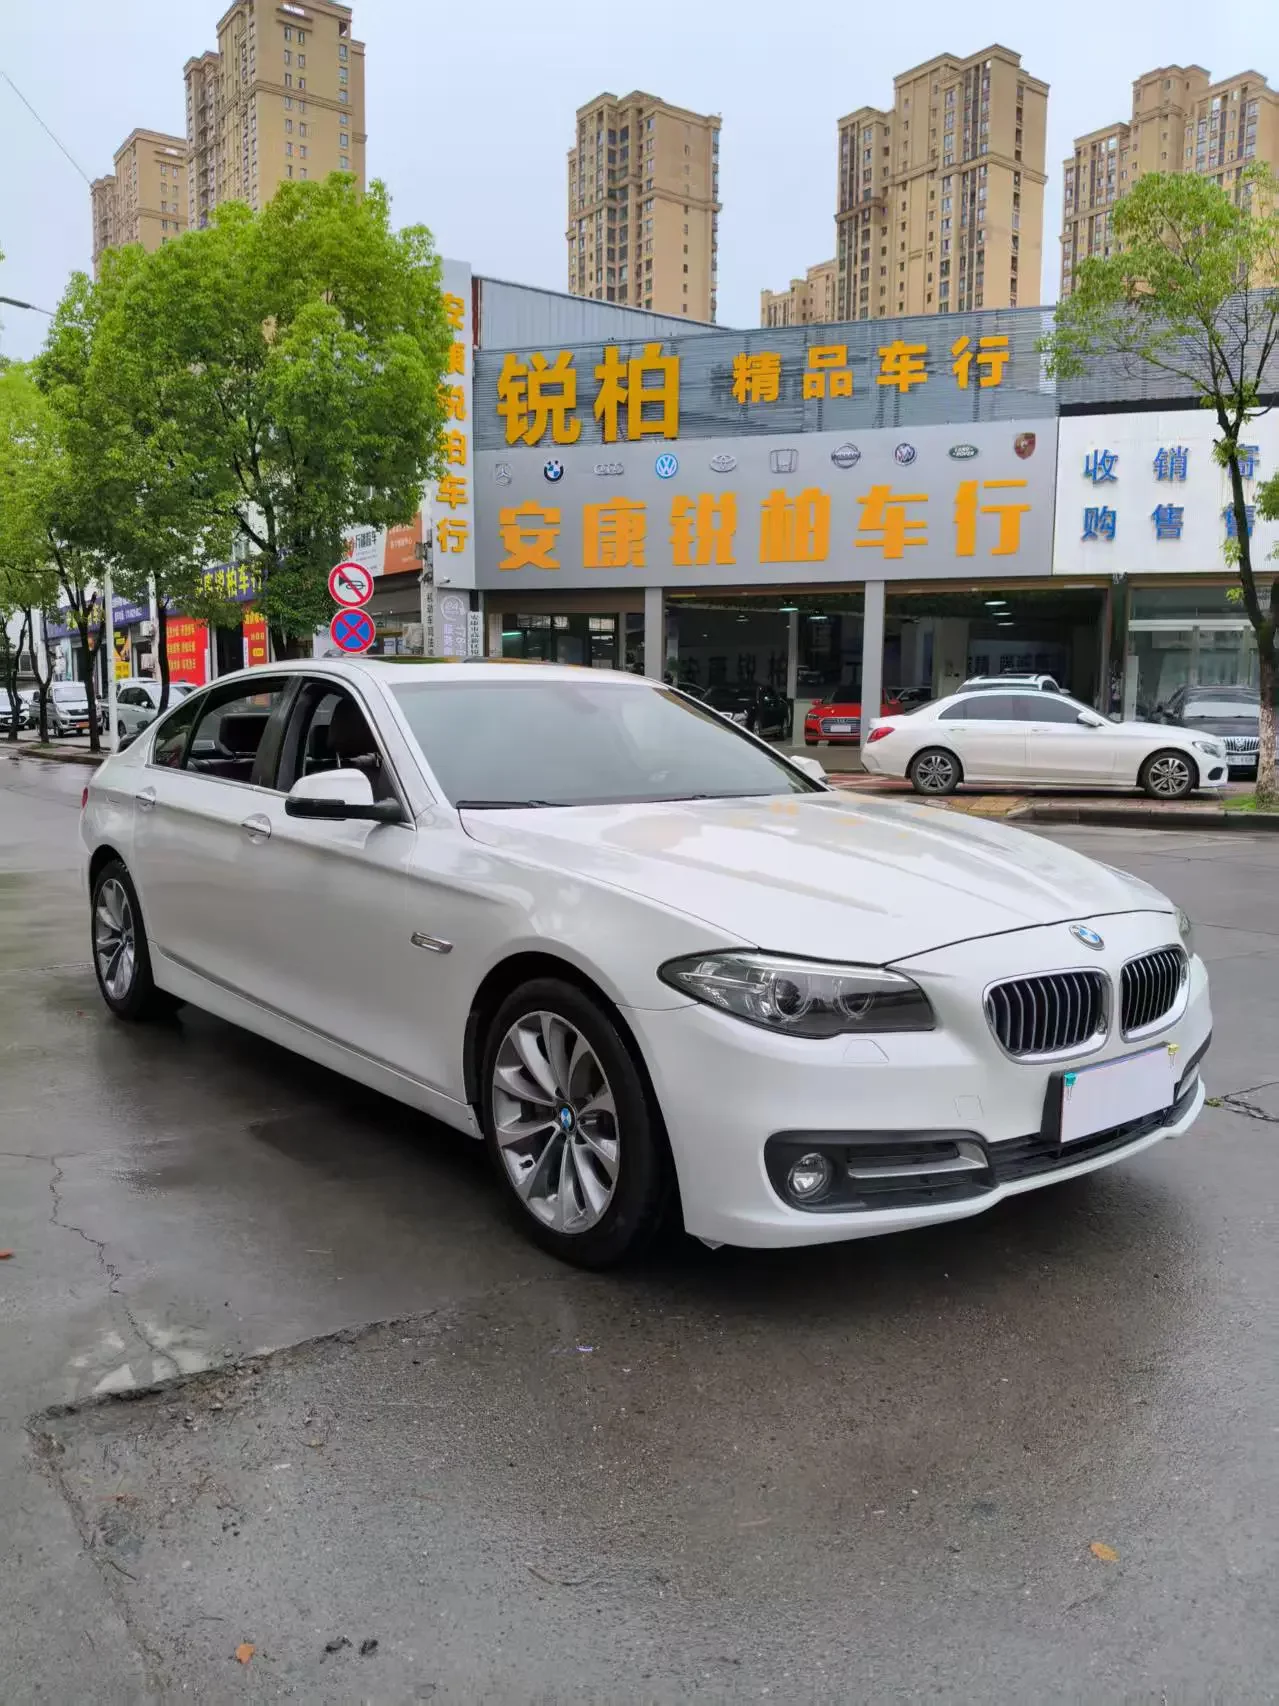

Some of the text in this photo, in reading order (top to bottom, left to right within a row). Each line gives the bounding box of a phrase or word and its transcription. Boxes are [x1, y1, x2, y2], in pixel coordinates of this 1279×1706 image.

[497, 336, 1009, 446] 锐柏 精品车行
[498, 479, 1031, 570] 安康锐柏车行
